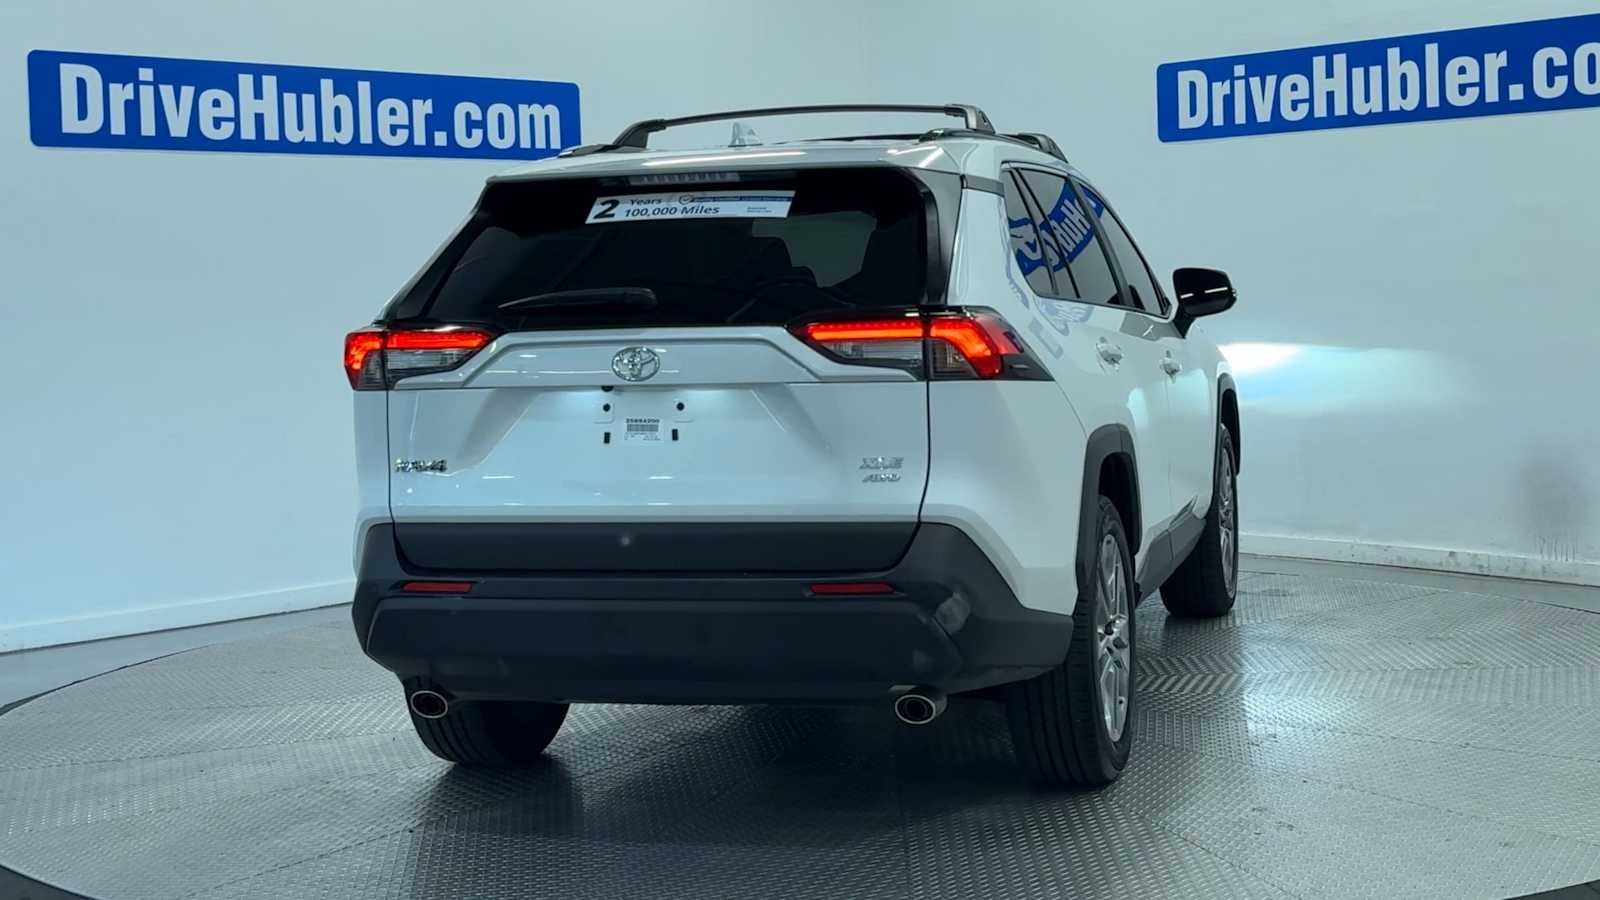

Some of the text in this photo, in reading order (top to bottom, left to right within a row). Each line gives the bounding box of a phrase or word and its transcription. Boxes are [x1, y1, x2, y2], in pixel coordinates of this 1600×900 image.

[58, 62, 562, 150] DriveHubler.com
[593, 198, 620, 219] 2
[630, 197, 662, 205] Years
[624, 205, 720, 218] 100,000 Miles
